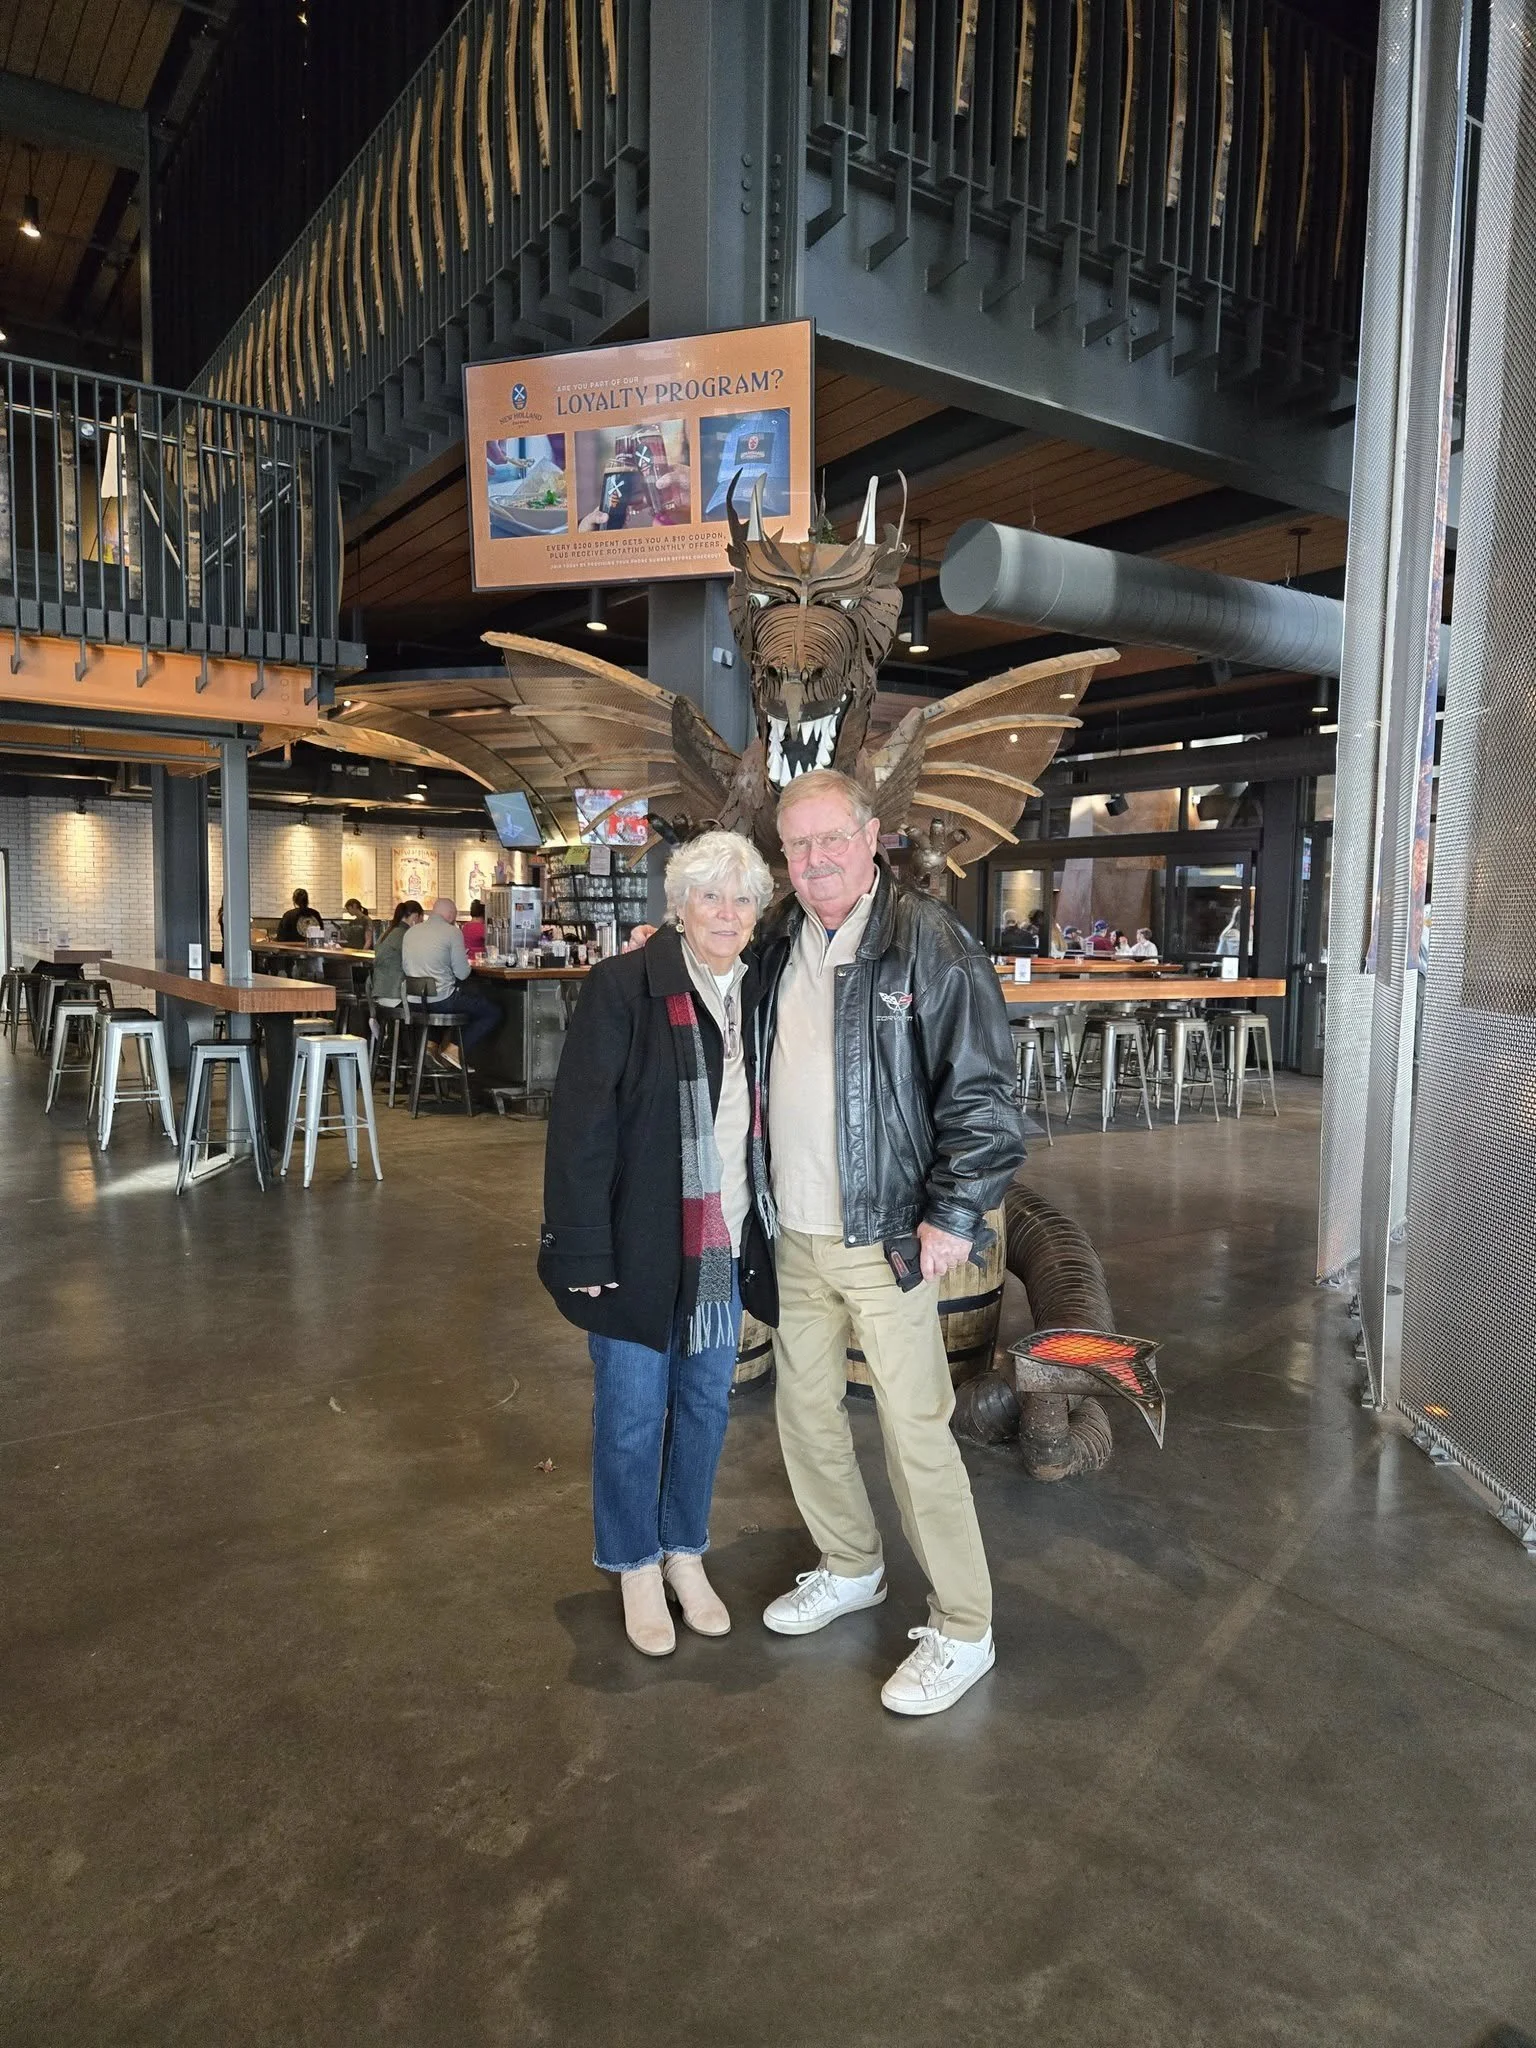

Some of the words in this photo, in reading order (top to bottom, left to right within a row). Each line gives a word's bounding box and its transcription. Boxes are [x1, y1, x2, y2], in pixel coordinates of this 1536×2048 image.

[590, 381, 609, 389] PART
[623, 376, 639, 384] OUR
[557, 385, 648, 416] LOYALTY
[655, 368, 784, 404] PROGRAM?
[499, 414, 513, 425] NEW
[513, 411, 542, 421] HOLLAND
[546, 544, 571, 552] EVERY
[594, 540, 619, 548] SPENT
[622, 538, 643, 546] GETS
[672, 535, 686, 543] $10
[688, 532, 726, 541] COUPON,
[571, 549, 603, 558] RECEIVE
[606, 547, 645, 555] ROTATING
[648, 543, 686, 553] MONTHLY
[688, 541, 723, 549] OFFERS.
